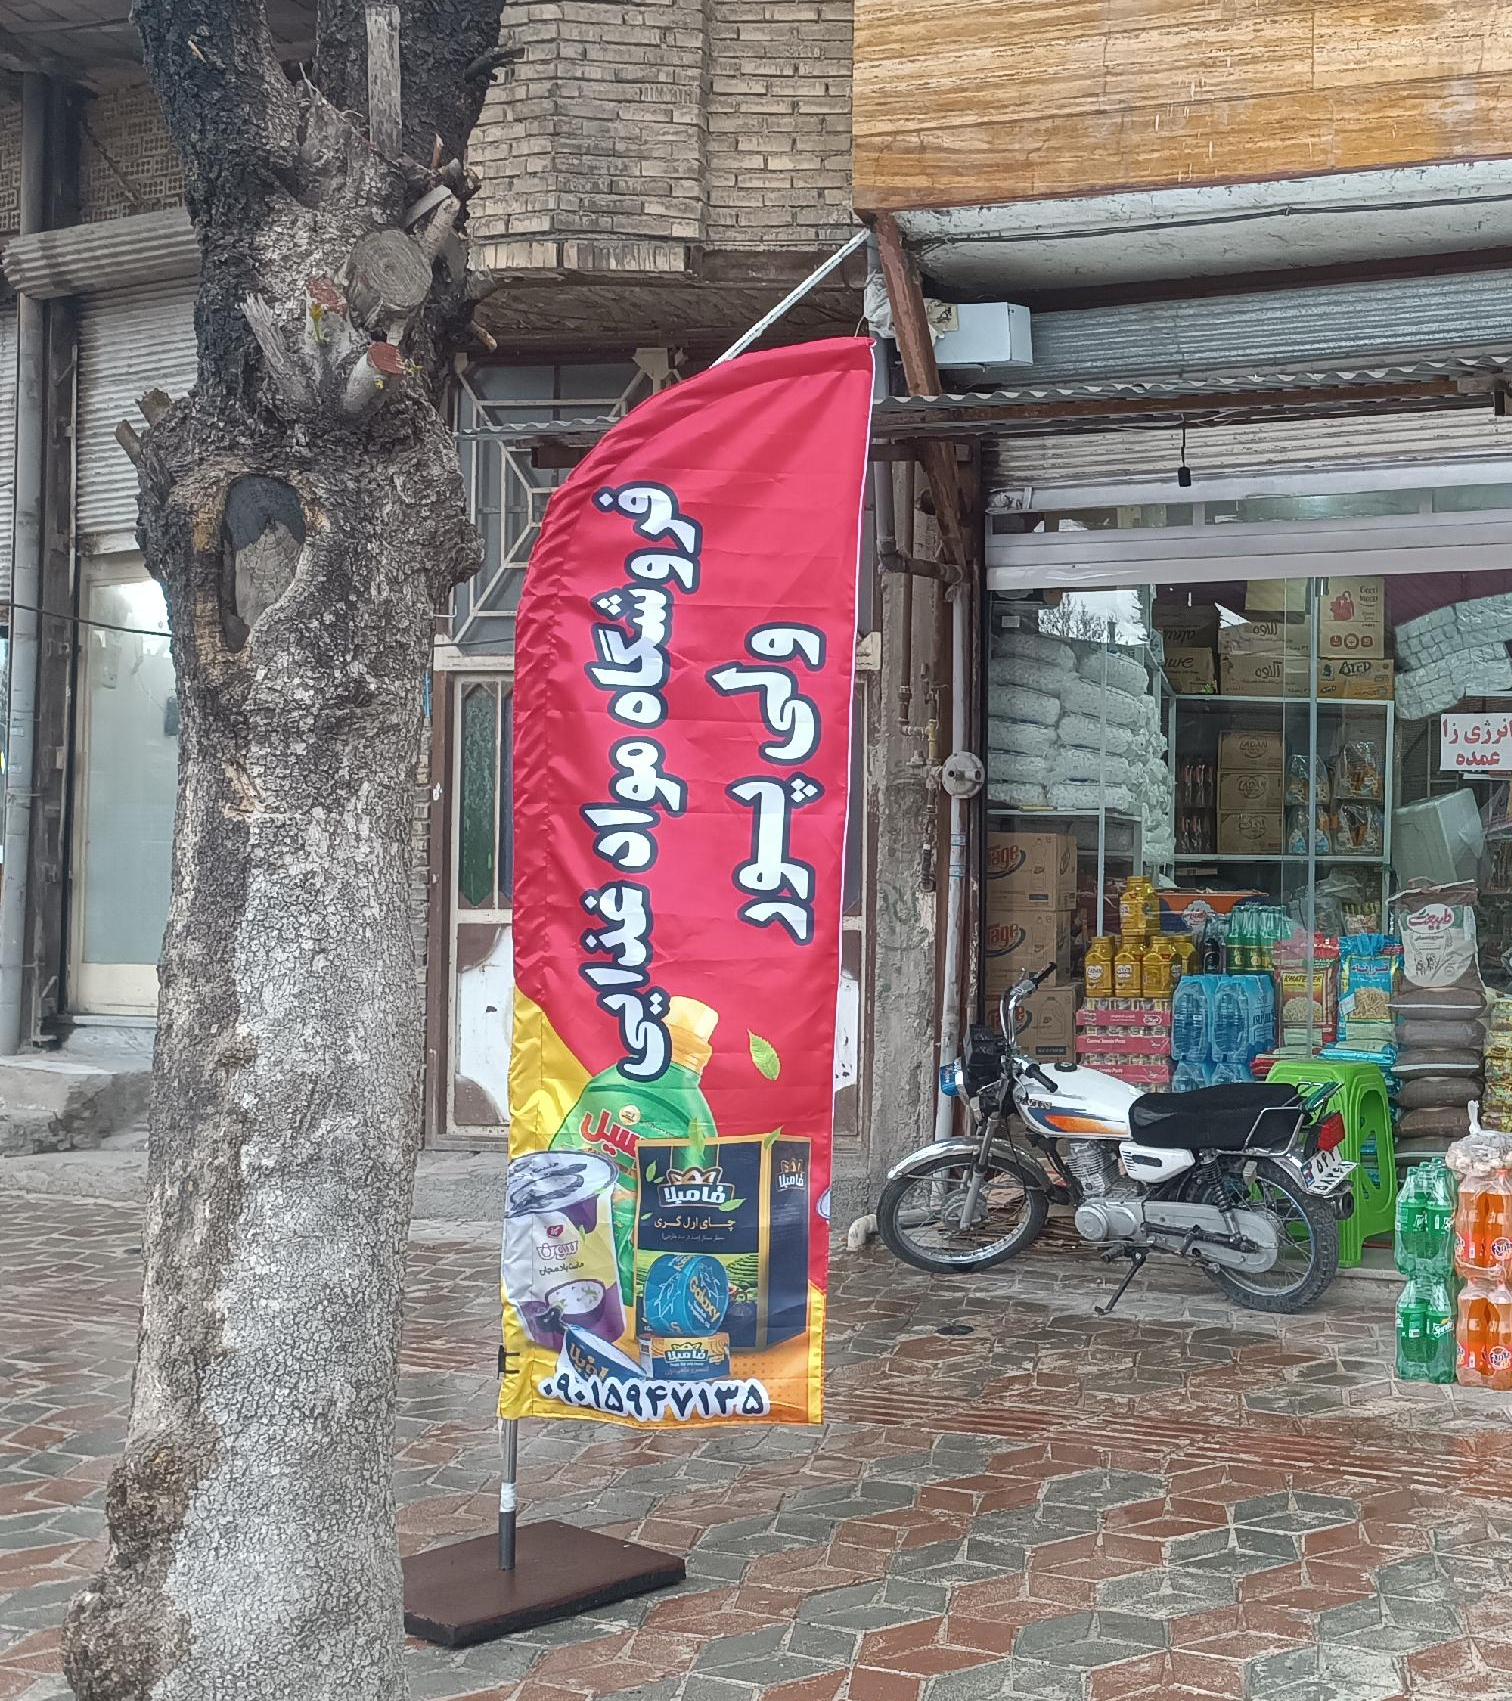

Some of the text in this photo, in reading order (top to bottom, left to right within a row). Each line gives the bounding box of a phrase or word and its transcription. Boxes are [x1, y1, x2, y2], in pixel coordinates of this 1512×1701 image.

[1443, 718, 1458, 744] زا
[1456, 751, 1500, 766] عمده
[578, 481, 702, 1082] فروشگاه مواد غذایی
[707, 621, 826, 945] ولی پور
[1409, 908, 1452, 930] طبیعت
[664, 1185, 726, 1205] فامیلا
[682, 1217, 699, 1229] ارل
[700, 1217, 736, 1232] چای
[543, 1373, 764, 1418] ۰۹۰۱۵۹۴۷۱۳۵
